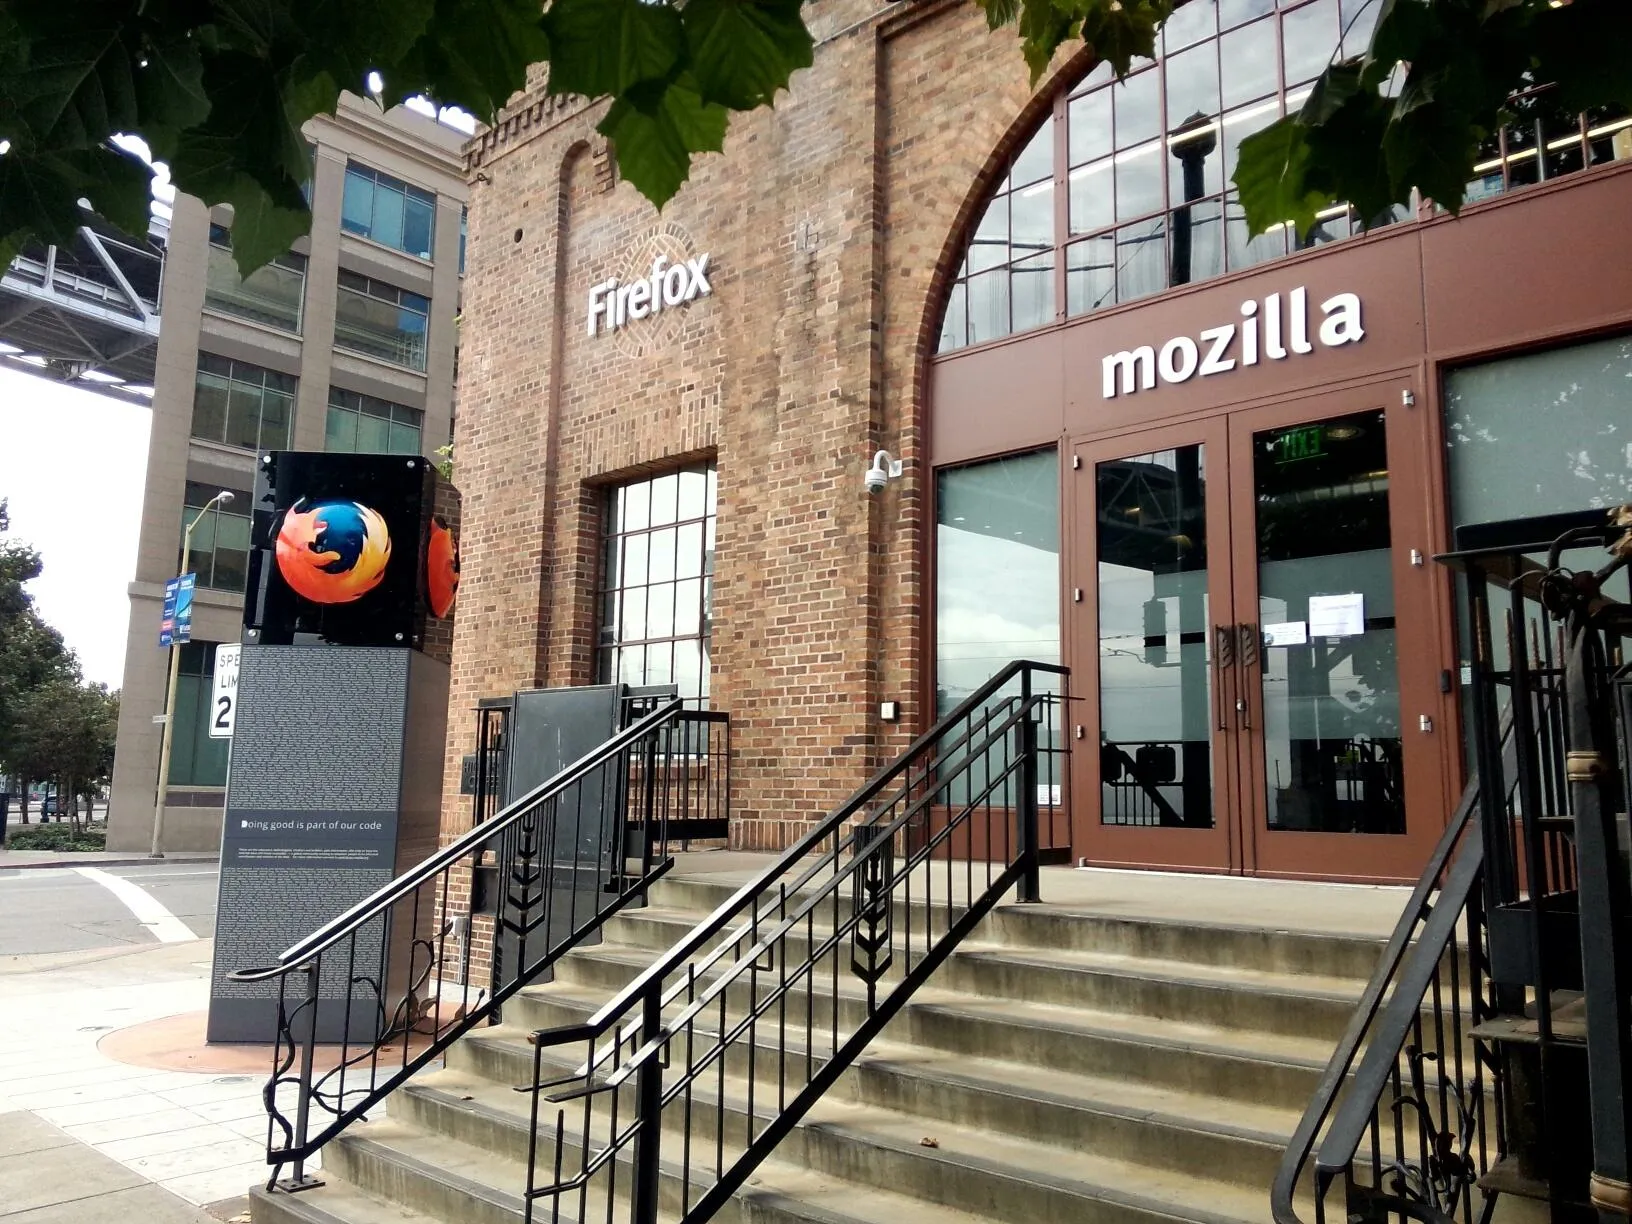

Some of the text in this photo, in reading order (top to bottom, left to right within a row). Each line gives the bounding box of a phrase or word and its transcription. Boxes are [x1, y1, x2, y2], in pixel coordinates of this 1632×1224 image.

[587, 252, 711, 337] Firefox
[1101, 286, 1365, 398] mozilla
[241, 820, 268, 830] Doing
[270, 820, 294, 830] good
[296, 821, 304, 829] is
[306, 821, 326, 831] part
[329, 821, 338, 829] of
[359, 821, 382, 829] code
